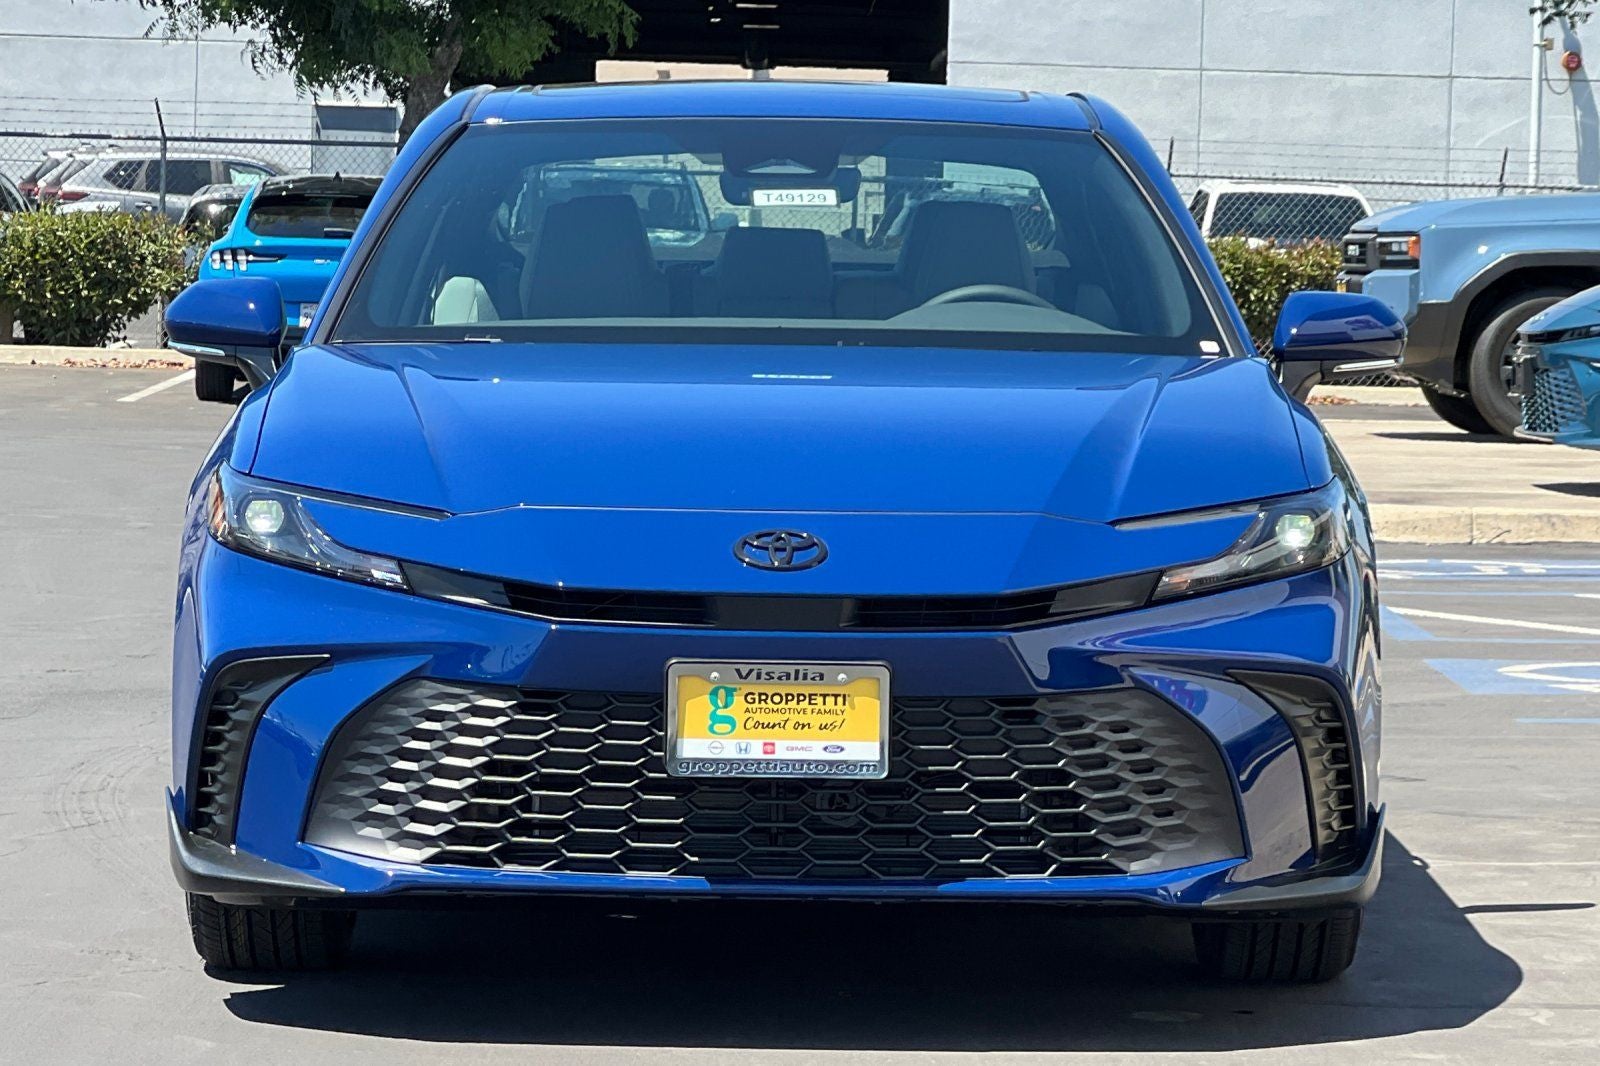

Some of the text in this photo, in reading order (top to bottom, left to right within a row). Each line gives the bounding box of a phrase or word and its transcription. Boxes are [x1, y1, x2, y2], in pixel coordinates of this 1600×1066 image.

[762, 193, 827, 203] T49129
[734, 668, 825, 682] Visalia
[743, 692, 847, 706] GROPPETTI
[743, 707, 846, 716] AUTOMOTIVE FAMILY
[743, 717, 846, 732] Count on us!
[677, 760, 879, 775] groppettiauto.com
